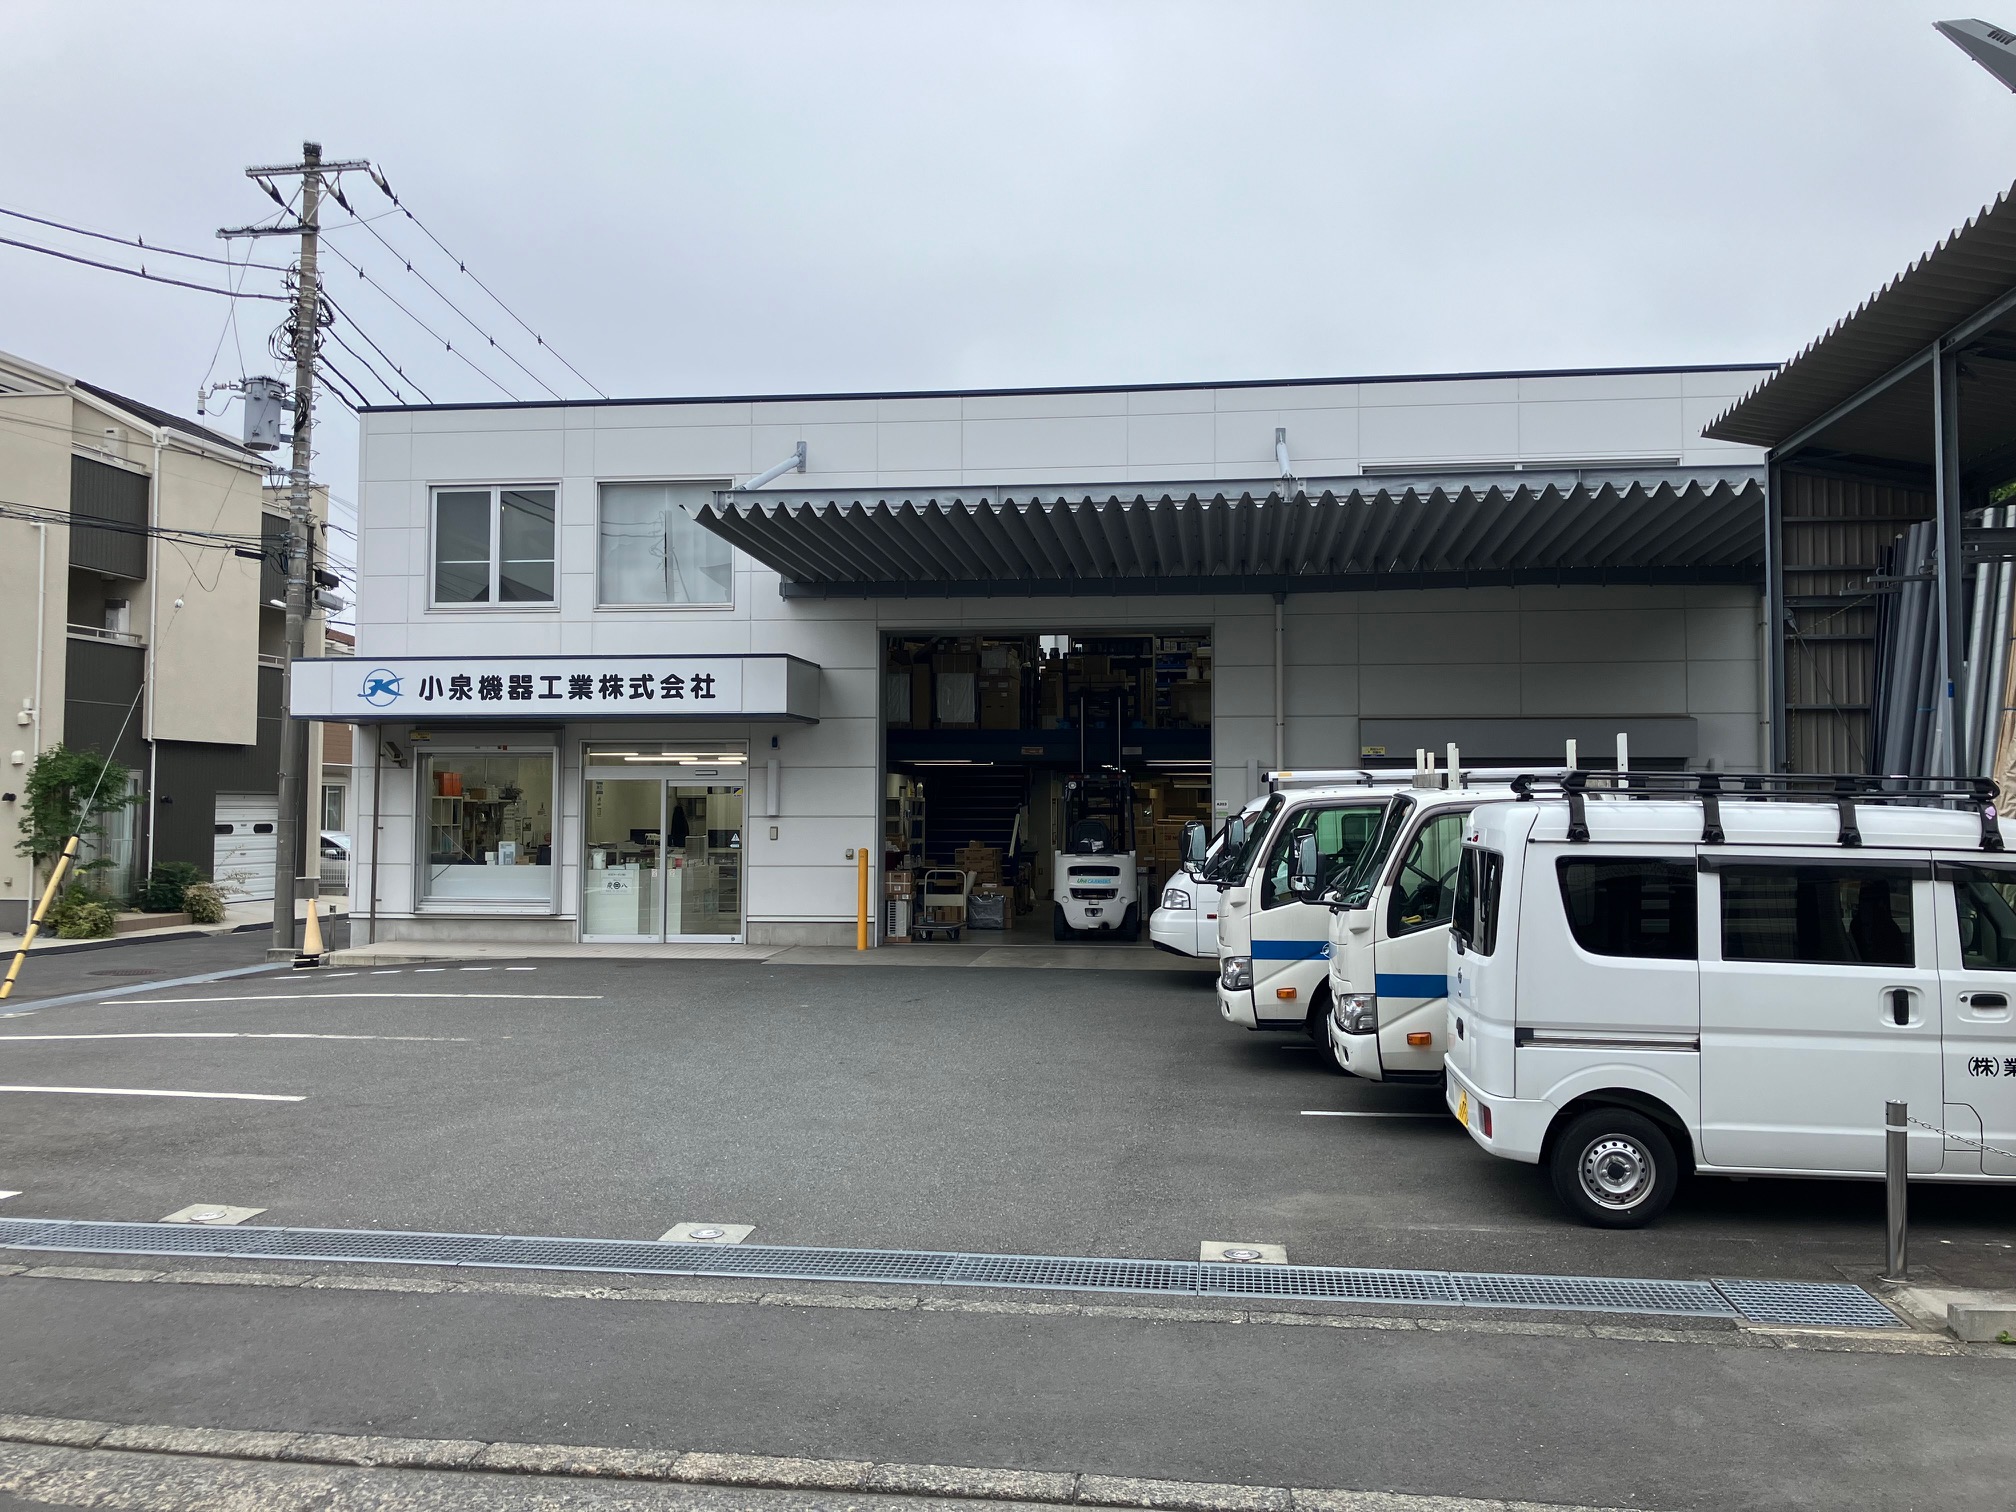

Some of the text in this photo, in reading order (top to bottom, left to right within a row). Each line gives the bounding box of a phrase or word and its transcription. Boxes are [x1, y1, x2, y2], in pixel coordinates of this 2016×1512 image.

[419, 673, 716, 701] 小泉機器工業株式会社
